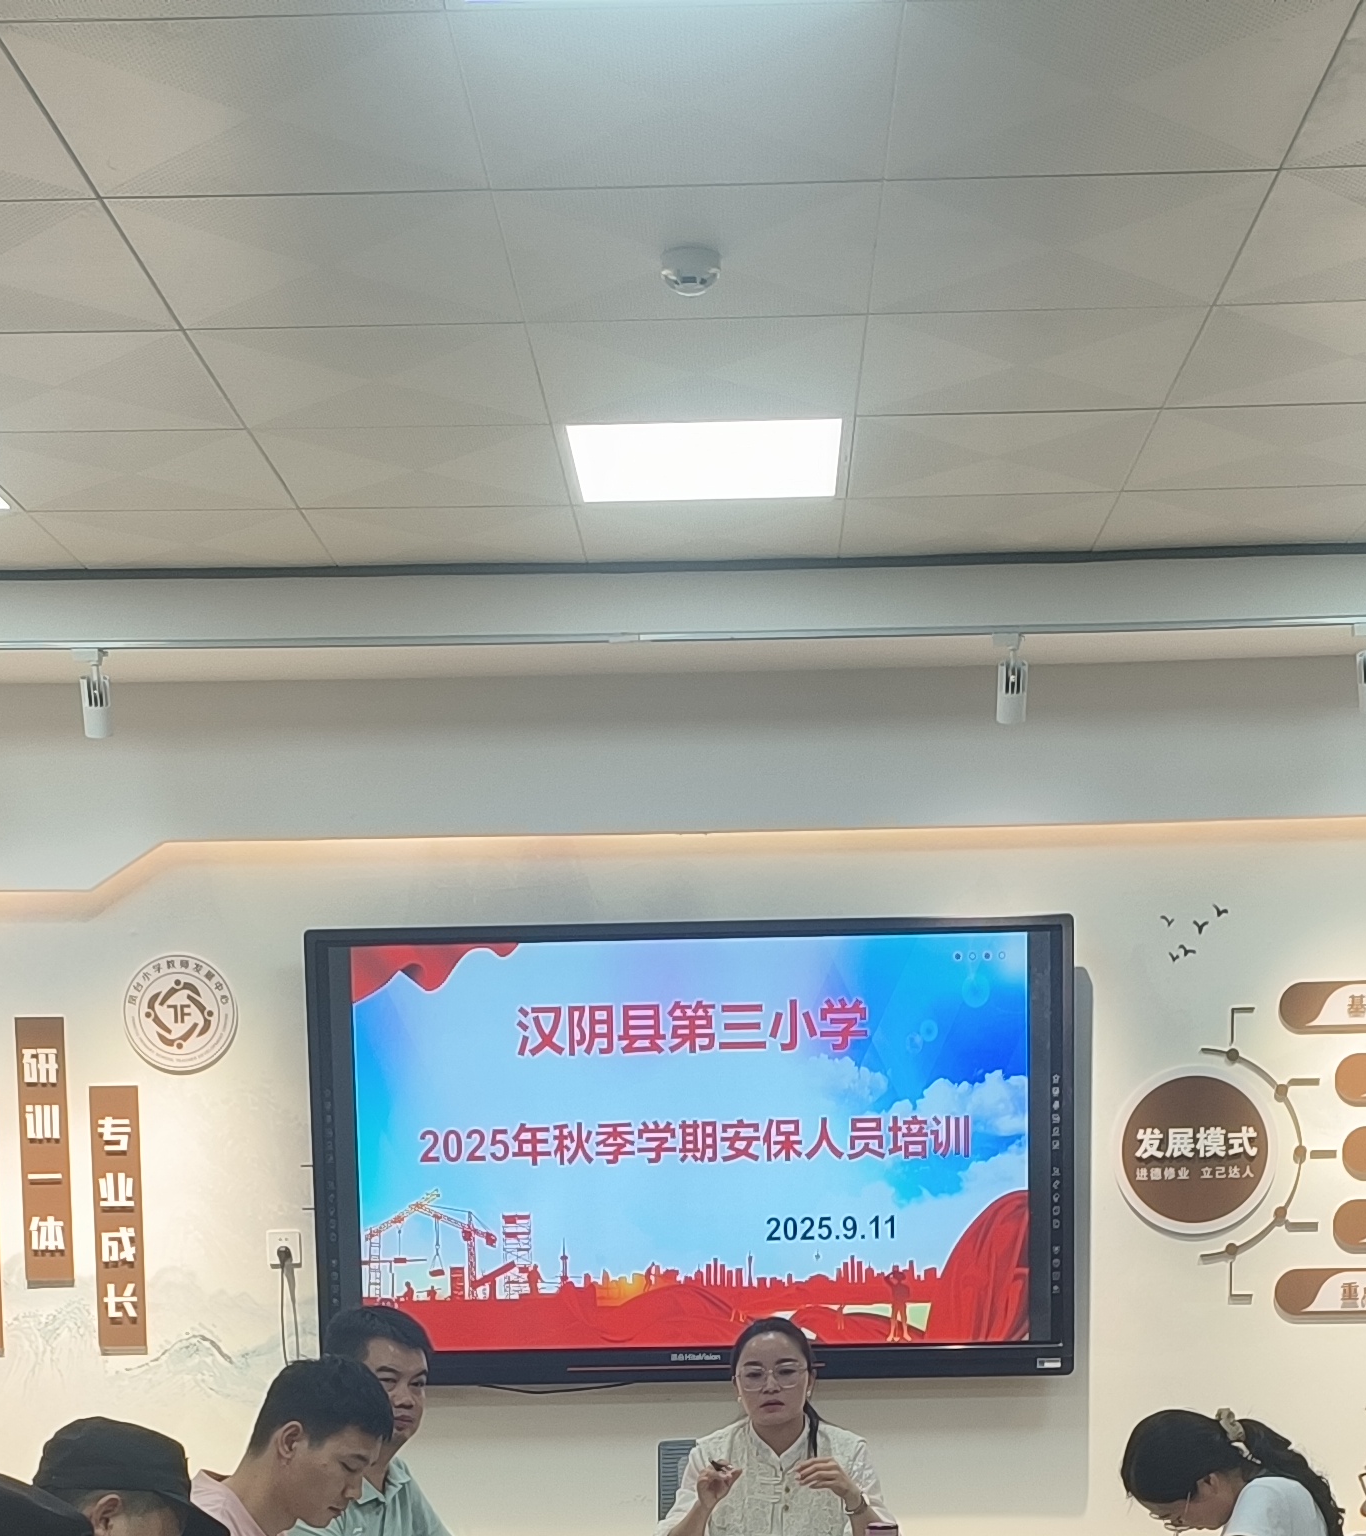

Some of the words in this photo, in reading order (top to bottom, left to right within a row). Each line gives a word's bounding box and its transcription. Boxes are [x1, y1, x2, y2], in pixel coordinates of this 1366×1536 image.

[516, 997, 869, 1058] 汉阴县第三小学
[22, 1047, 66, 1253] 研训一体
[419, 1115, 973, 1167] 2025年秋季学期安保人员培训
[1134, 1125, 1259, 1159] 发展模式
[1135, 1166, 1190, 1181] 进德修业
[1199, 1164, 1255, 1179] 立己达人
[96, 1115, 139, 1320] 专业成长
[765, 1214, 898, 1243] 2025.9.11
